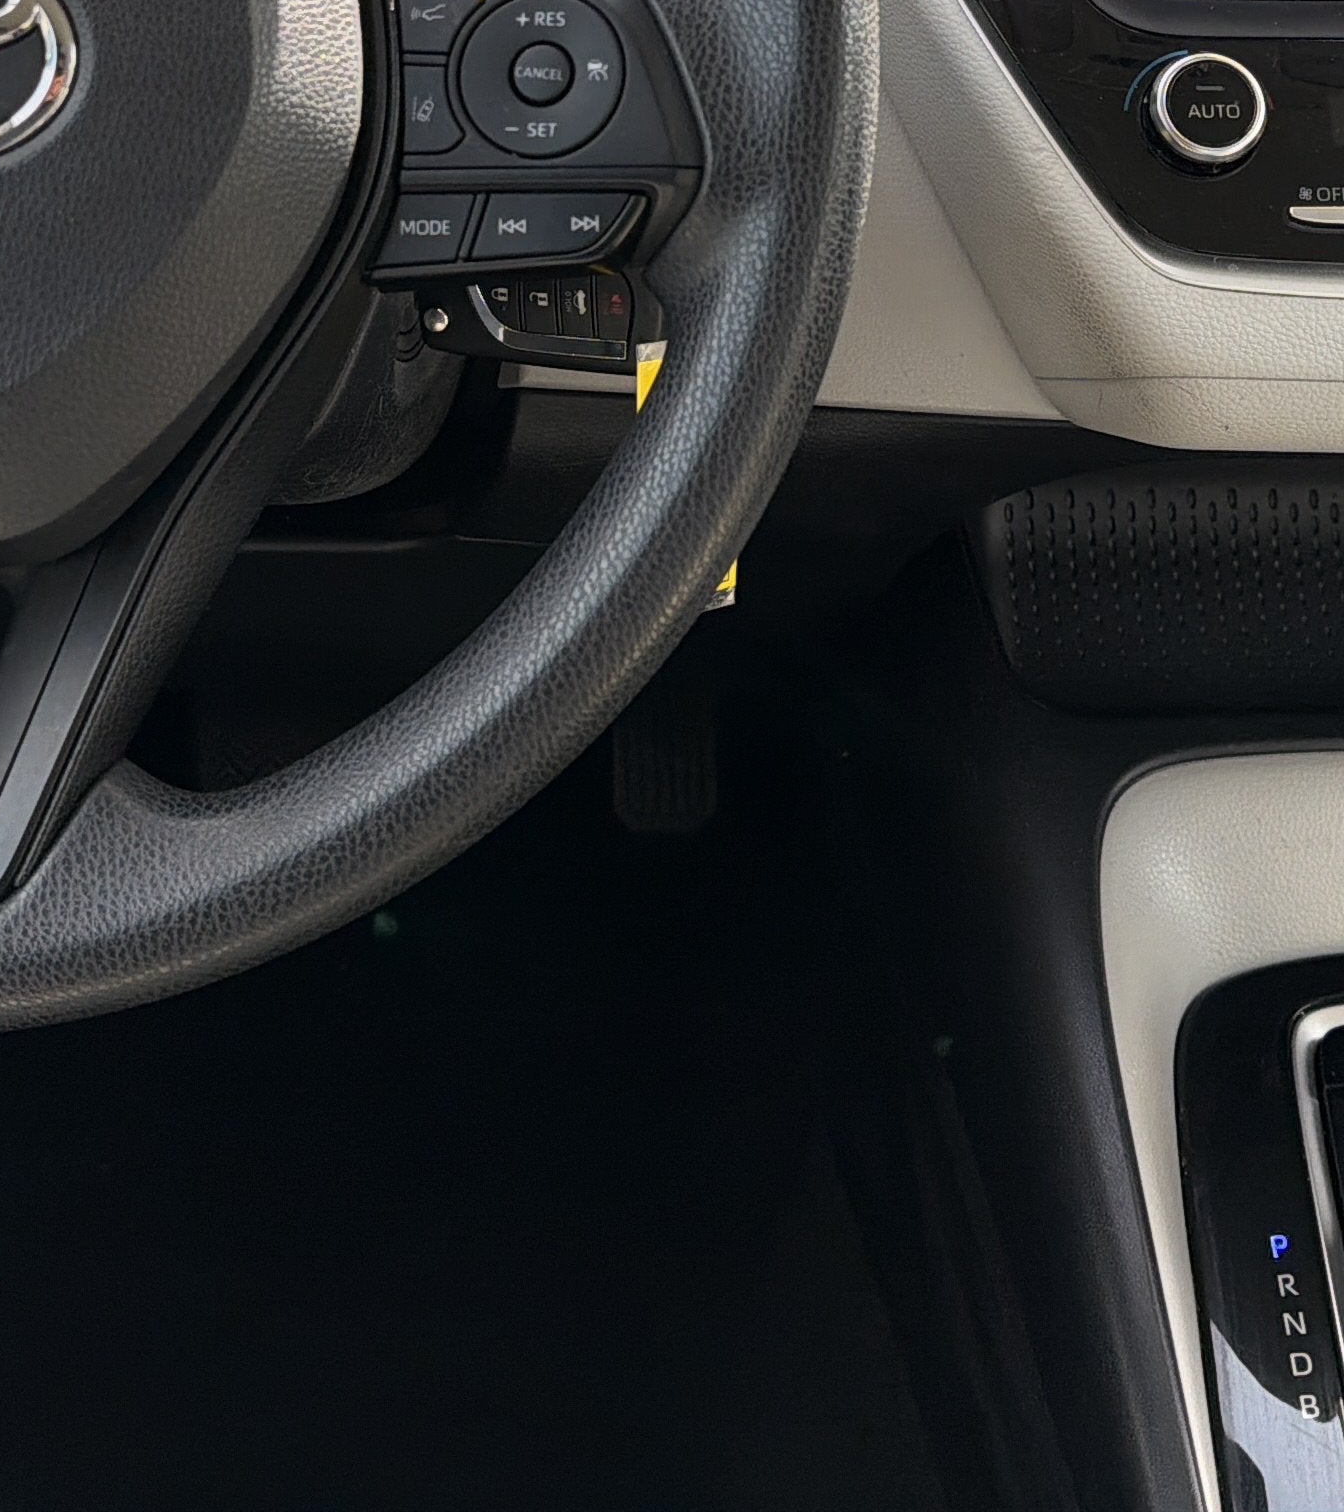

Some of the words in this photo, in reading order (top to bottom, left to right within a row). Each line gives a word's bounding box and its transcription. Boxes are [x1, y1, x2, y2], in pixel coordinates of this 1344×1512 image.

[514, 66, 563, 82] CANCEL
[1188, 104, 1241, 119] AUTO
[399, 219, 451, 235] MODE
[1269, 1233, 1290, 1261] P
[1276, 1272, 1300, 1298] R
[1283, 1310, 1308, 1337] N
[1289, 1350, 1314, 1377] D
[1299, 1393, 1321, 1420] B
